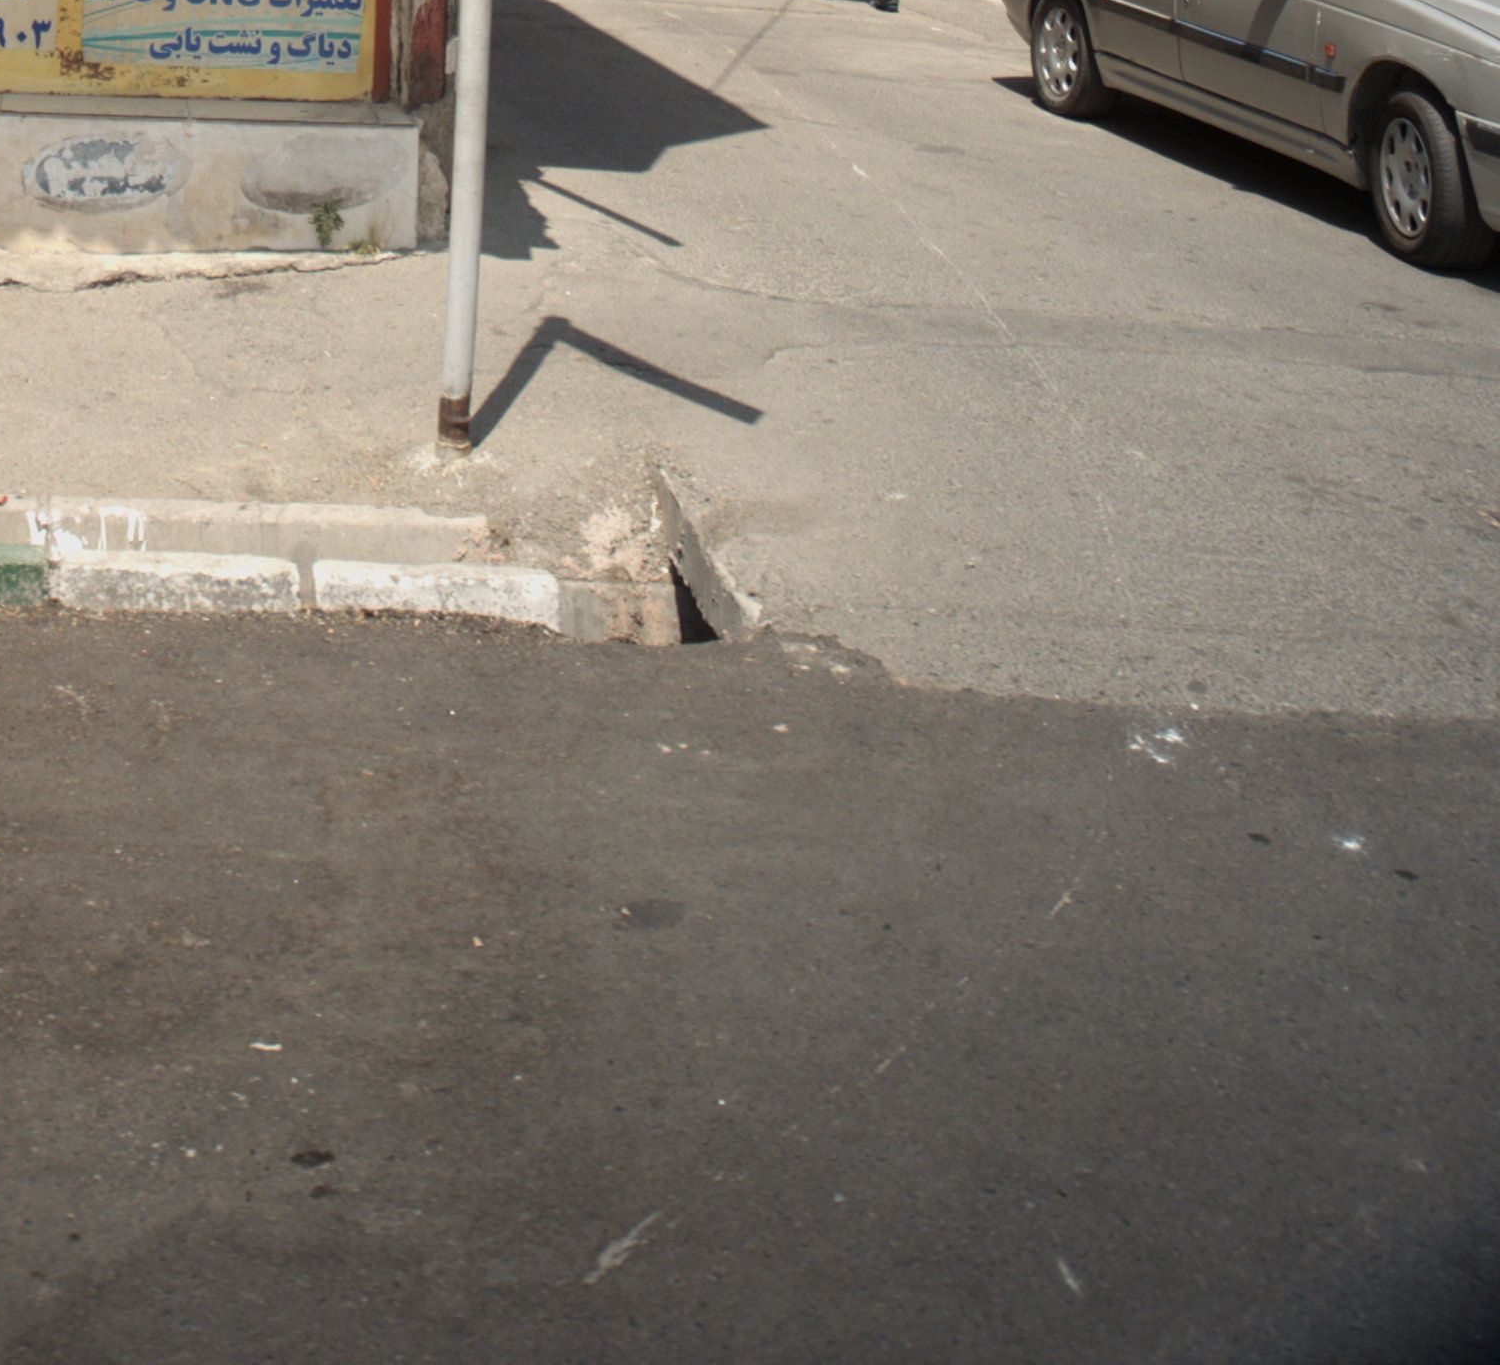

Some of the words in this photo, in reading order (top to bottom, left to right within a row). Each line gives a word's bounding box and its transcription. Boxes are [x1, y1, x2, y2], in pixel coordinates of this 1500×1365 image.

[149, 27, 202, 59] یابی
[208, 29, 262, 56] نشت
[266, 42, 281, 65] و
[287, 31, 352, 66] دیاگ
